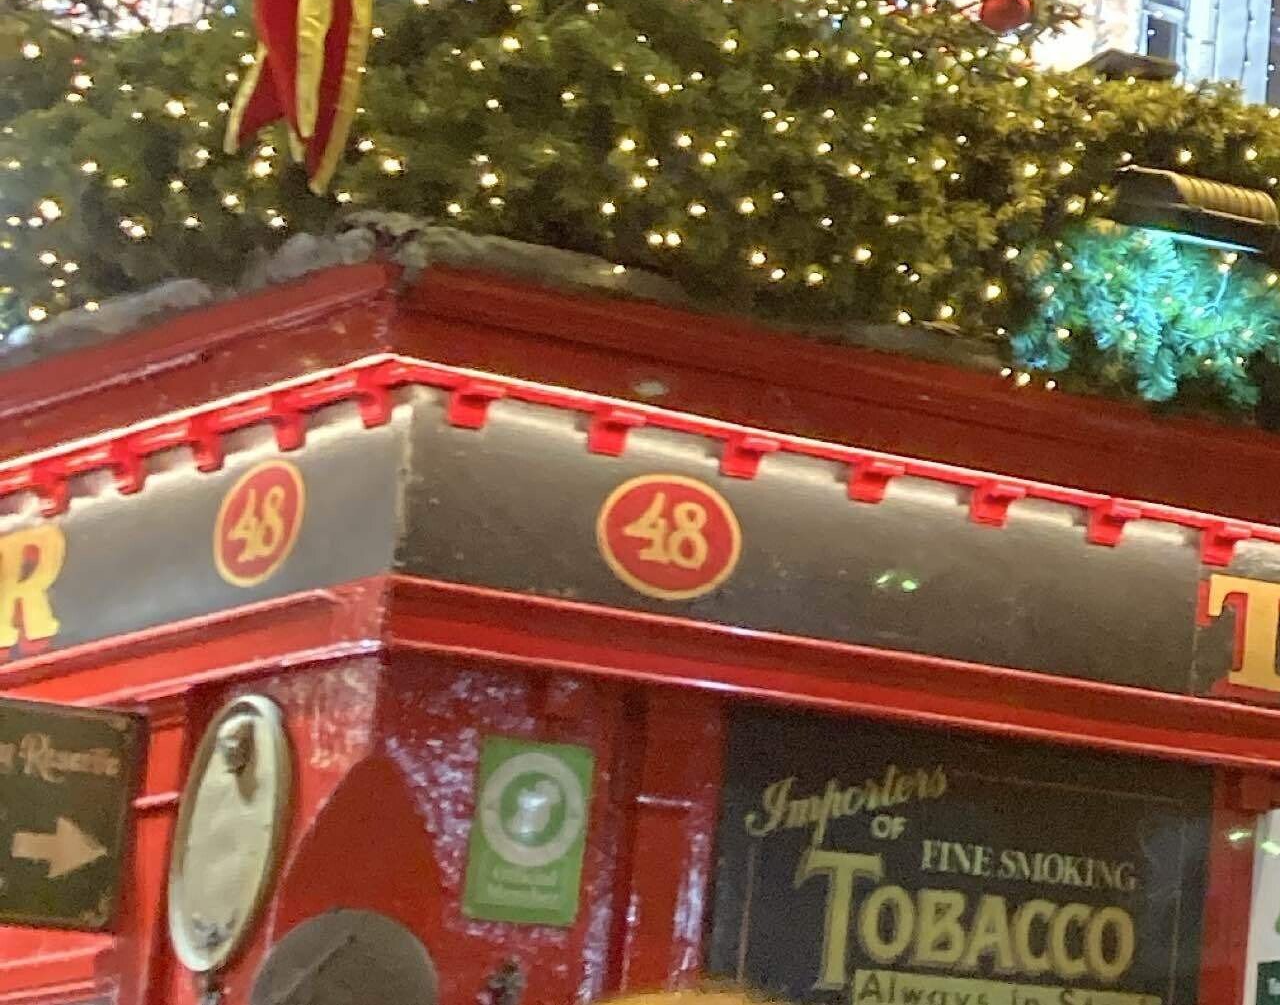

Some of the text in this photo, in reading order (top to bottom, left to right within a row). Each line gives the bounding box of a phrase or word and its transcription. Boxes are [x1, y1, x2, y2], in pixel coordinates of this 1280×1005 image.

[227, 487, 287, 563] 48
[622, 491, 709, 570] 48
[744, 764, 948, 844] Importers
[870, 815, 907, 840] OF
[921, 839, 1138, 891] FINE SMOKING
[794, 849, 1137, 991] TOBACCO
